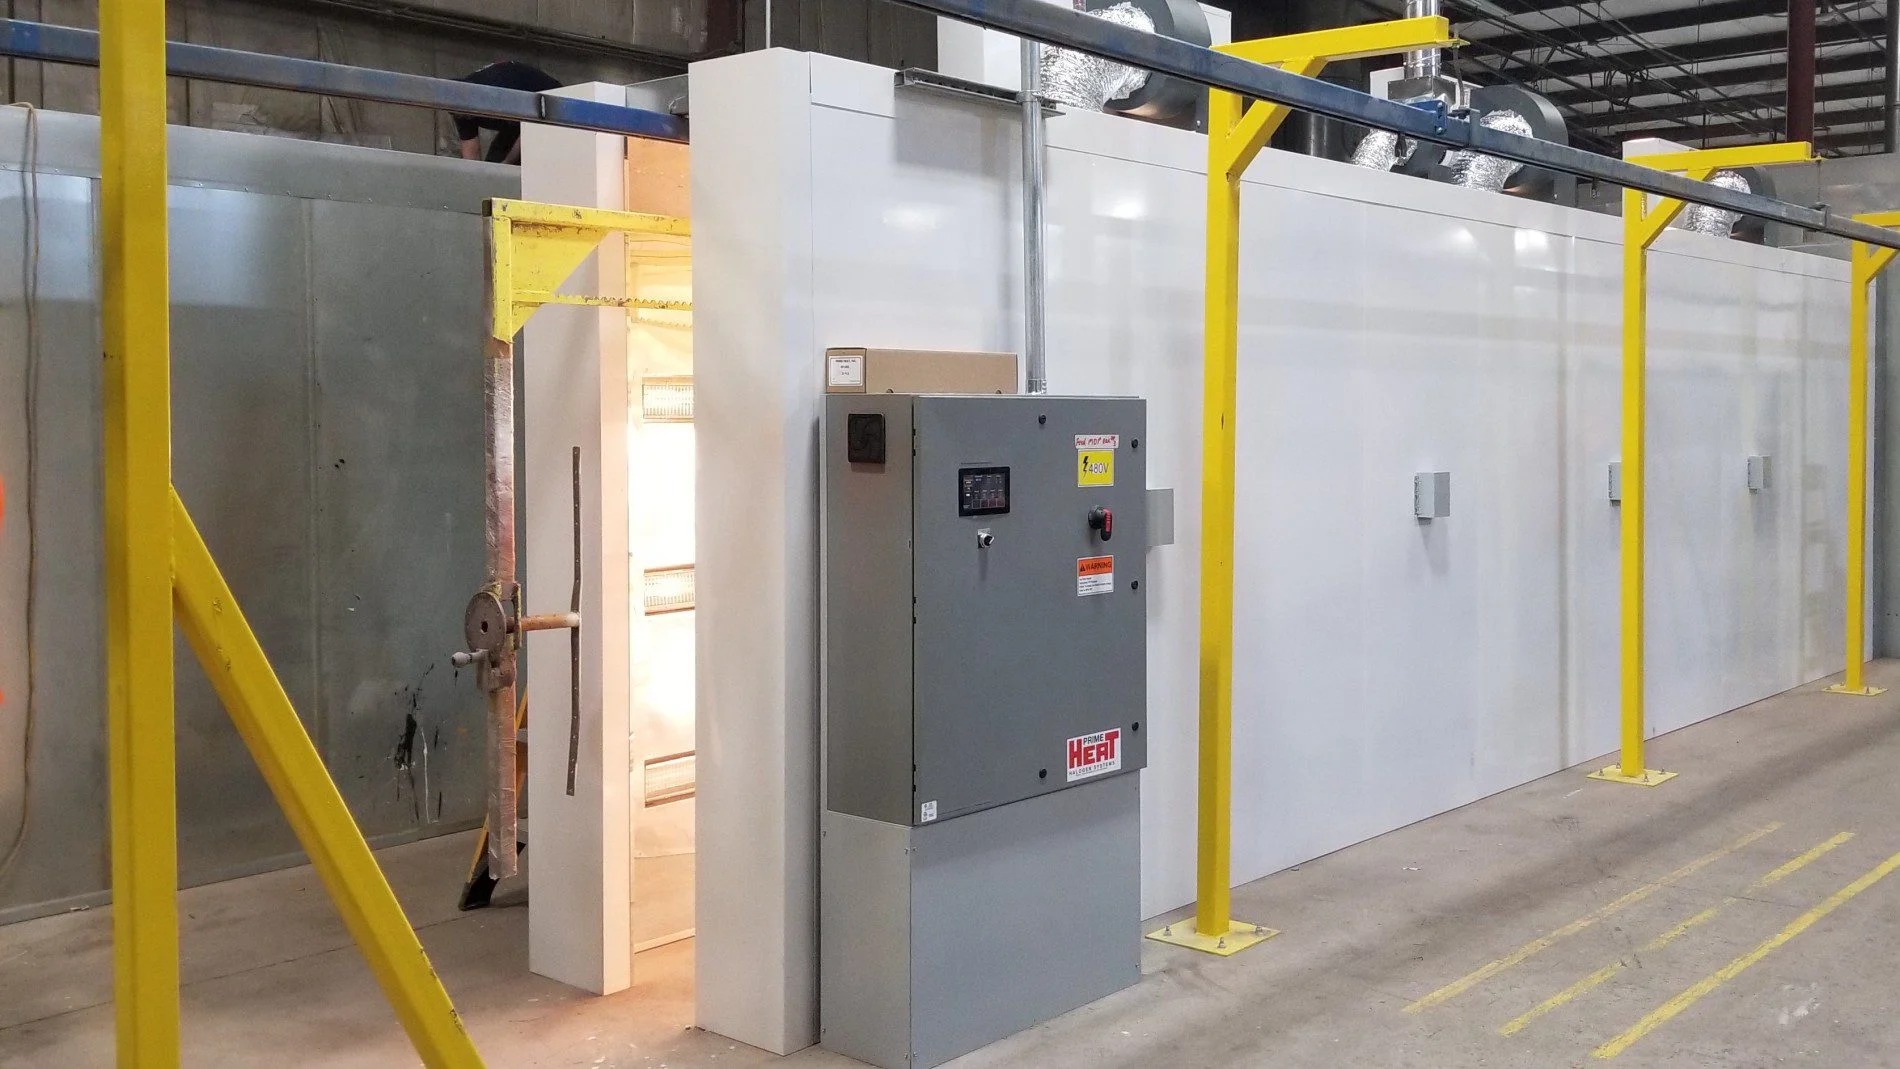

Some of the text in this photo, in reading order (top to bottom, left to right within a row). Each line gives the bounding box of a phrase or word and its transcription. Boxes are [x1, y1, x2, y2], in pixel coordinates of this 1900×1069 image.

[1089, 462, 1109, 474] 480V
[1085, 561, 1112, 571] WARNING
[1083, 733, 1104, 746] PRIME
[1069, 730, 1119, 770] HEAT
[1068, 766, 1092, 776] HALOGEN
[1093, 761, 1116, 770] SYSTEMS
